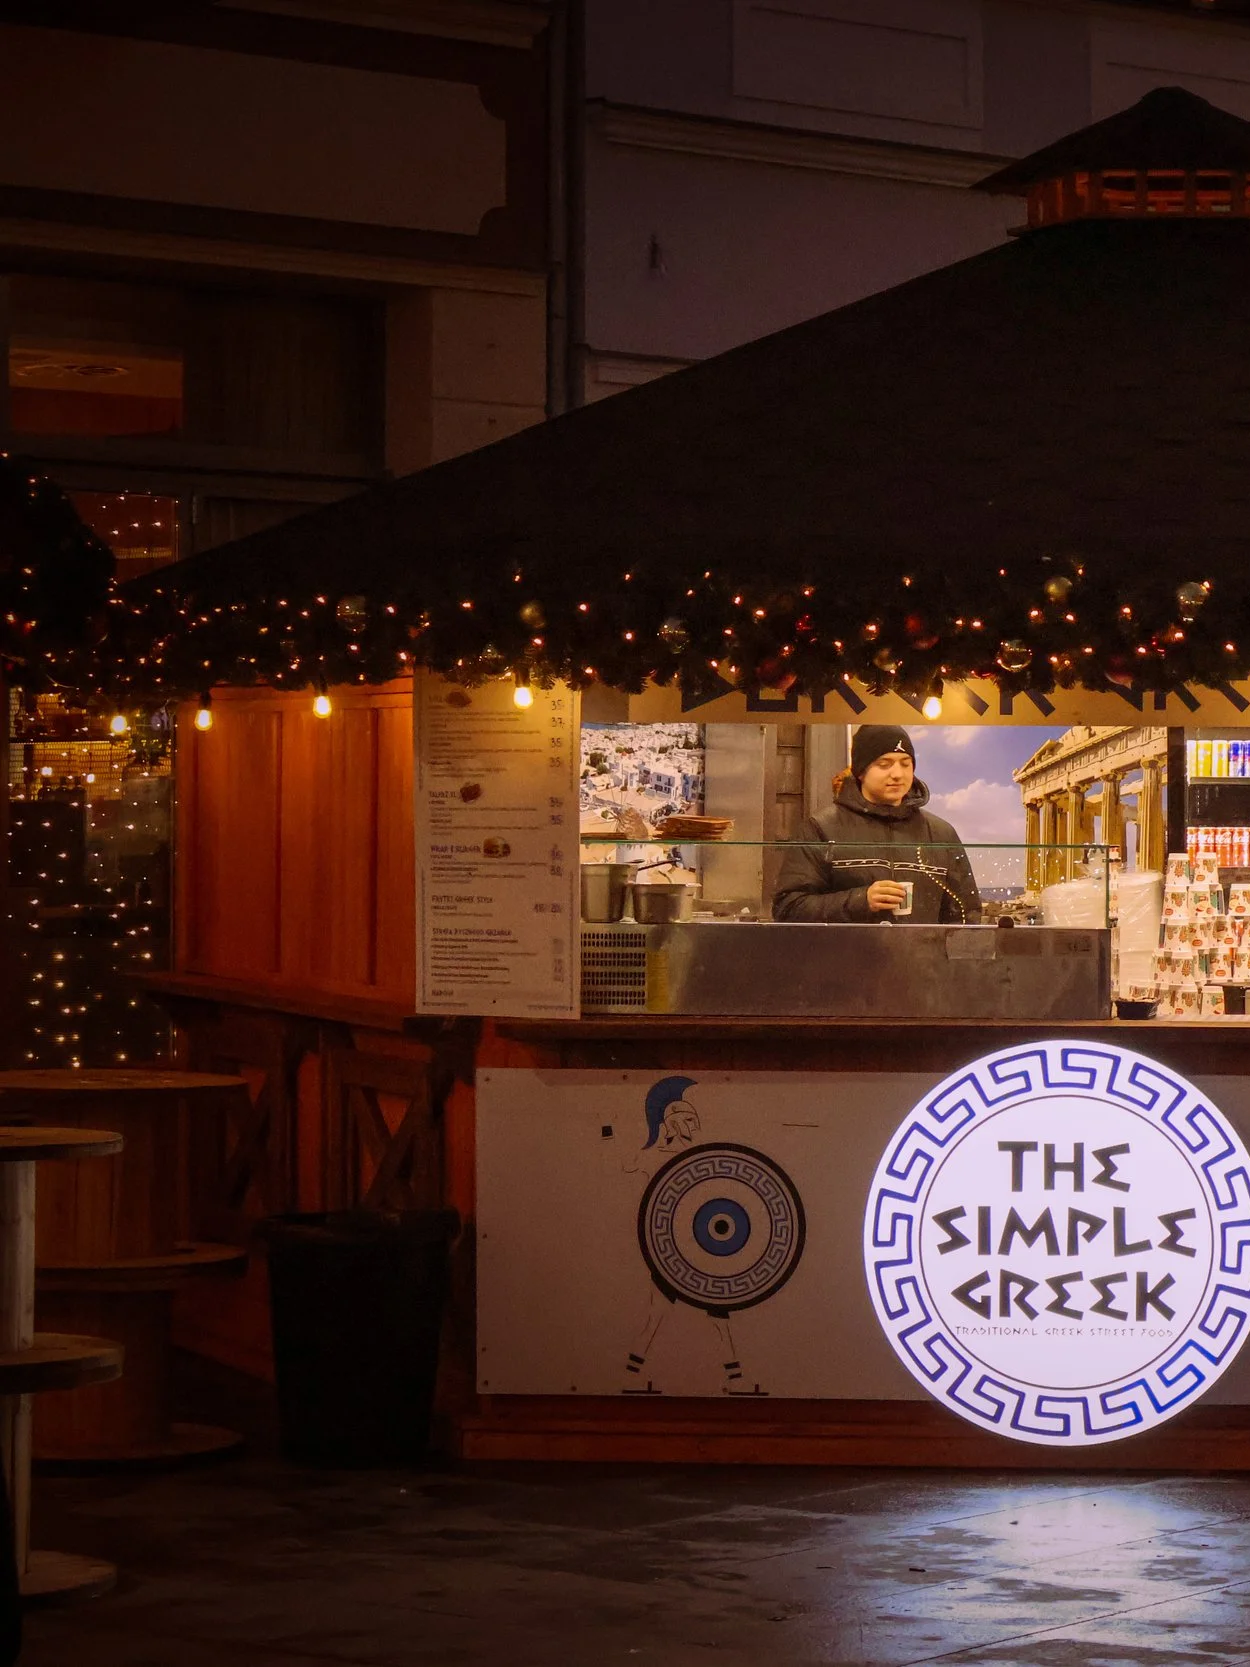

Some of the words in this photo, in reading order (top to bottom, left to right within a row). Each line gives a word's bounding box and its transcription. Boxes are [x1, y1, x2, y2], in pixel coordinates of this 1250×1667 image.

[997, 1140, 1131, 1192] THE
[931, 1205, 1197, 1258] SIMPLE
[950, 1268, 1177, 1322] GREEK
[955, 1326, 1039, 1337] TRADITIONAL
[1044, 1327, 1084, 1337] GREEK
[1089, 1327, 1135, 1338] STREET
[1141, 1328, 1175, 1338] FOOD
